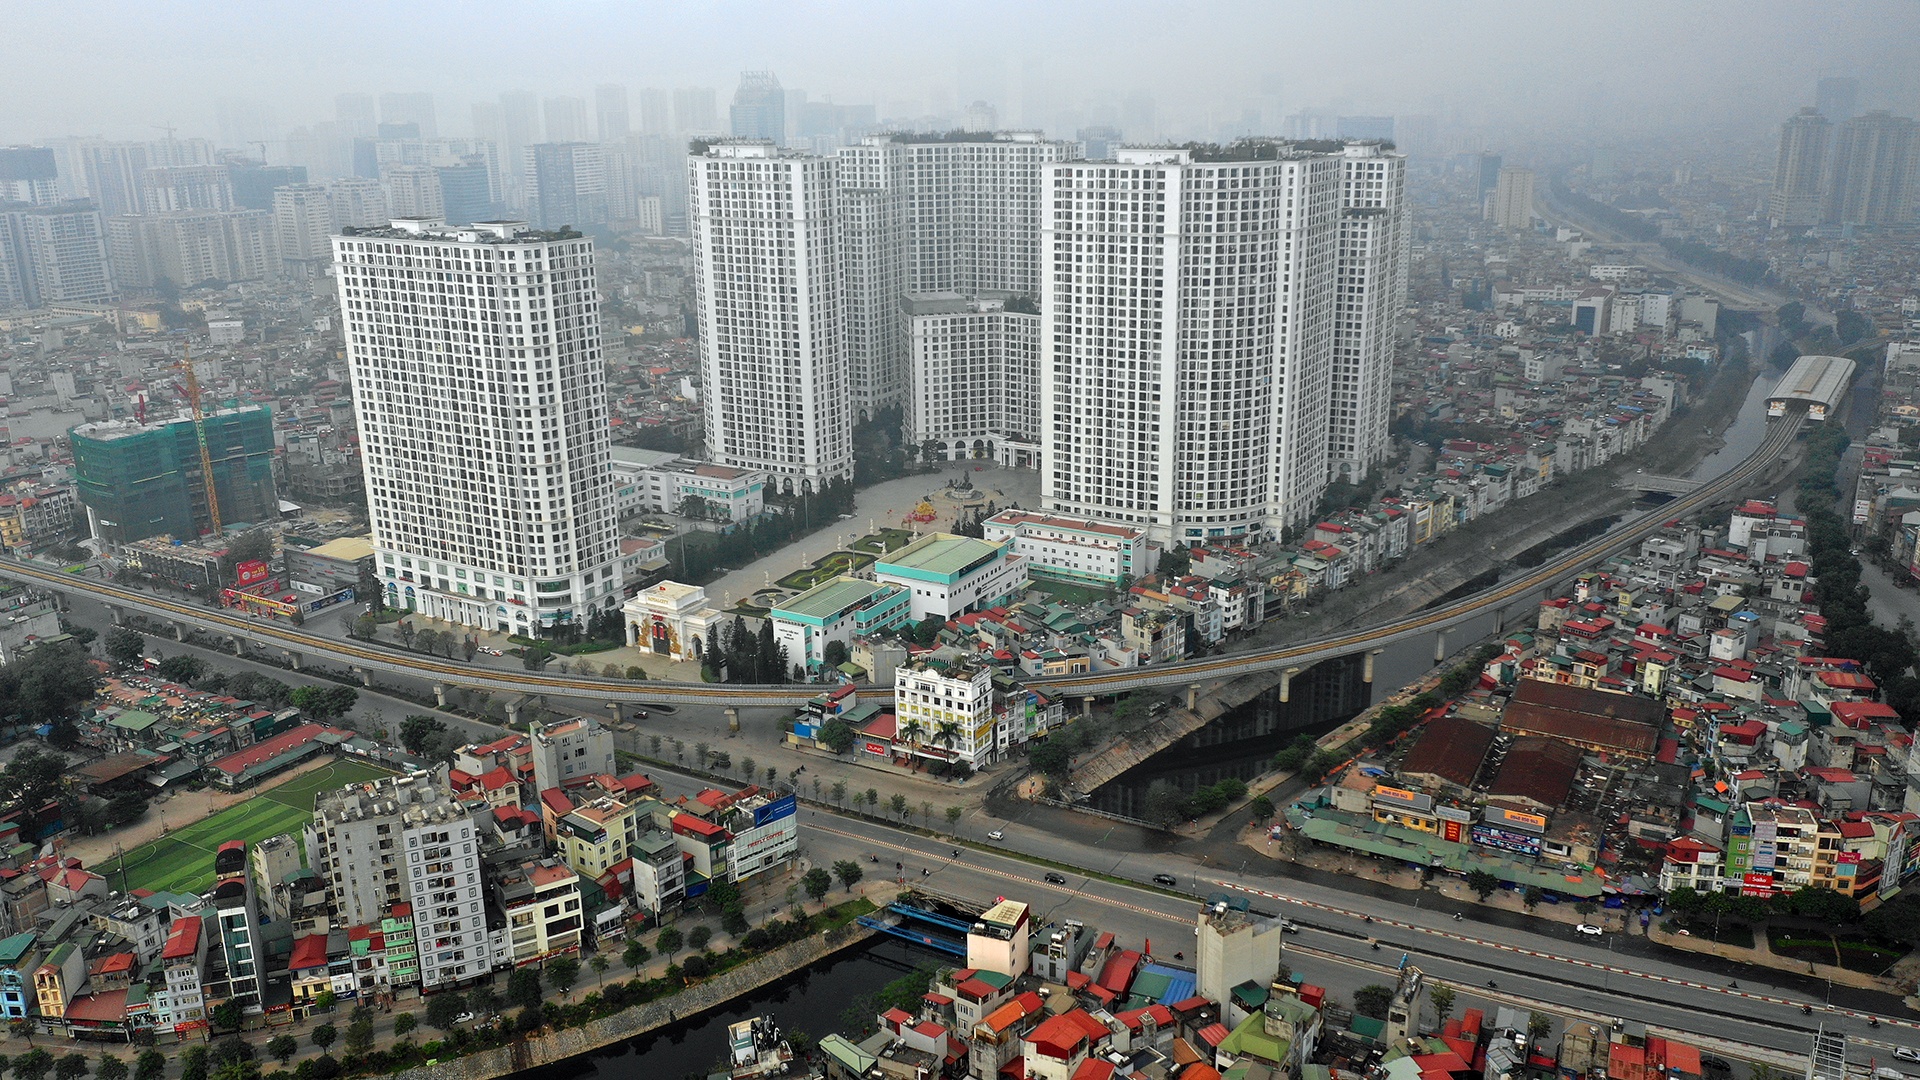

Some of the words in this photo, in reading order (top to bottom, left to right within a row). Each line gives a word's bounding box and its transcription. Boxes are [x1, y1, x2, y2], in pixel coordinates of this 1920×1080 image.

[867, 745, 883, 753] JUNO
[748, 838, 767, 848] FIREFLY
[767, 831, 785, 841] COFFEE
